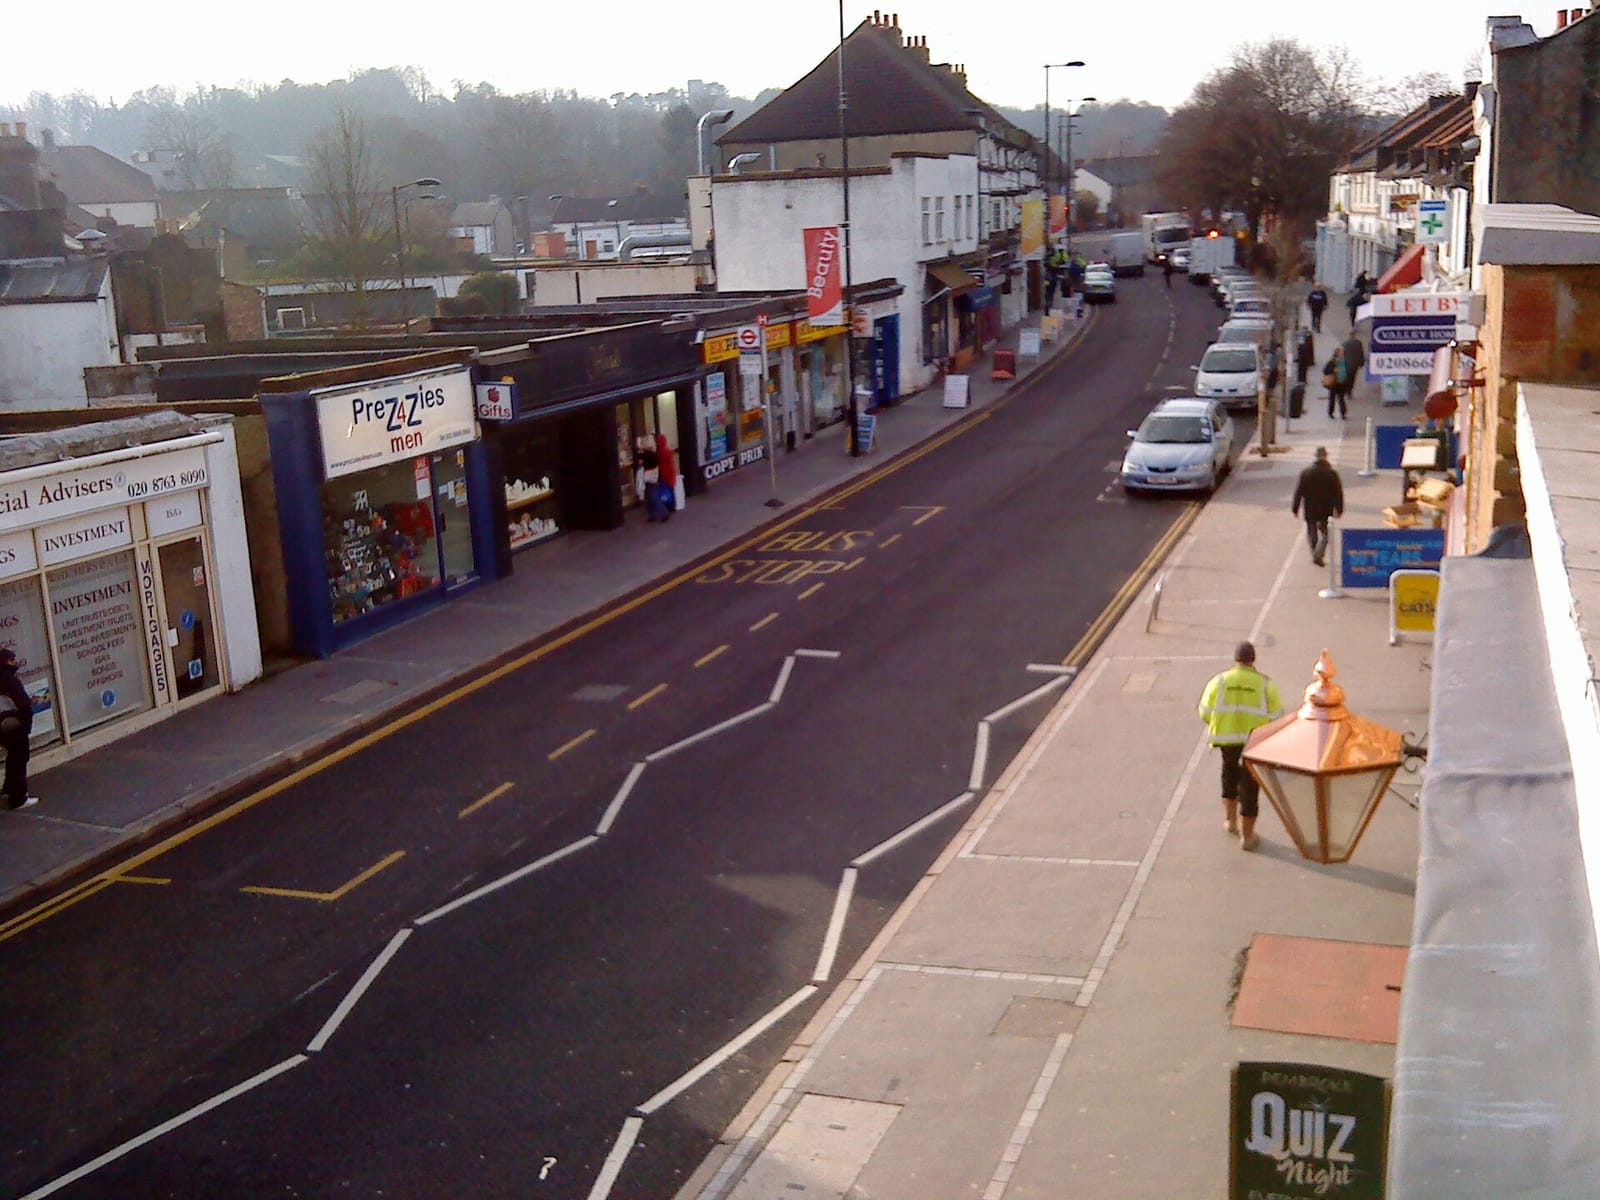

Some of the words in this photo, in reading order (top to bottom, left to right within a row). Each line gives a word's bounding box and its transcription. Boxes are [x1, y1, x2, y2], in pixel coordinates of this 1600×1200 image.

[807, 230, 838, 298] Beauty
[479, 403, 511, 418] Gifts
[391, 431, 423, 453] men
[704, 456, 736, 479] COPY
[38, 478, 114, 506] Advisers
[127, 482, 148, 497] 020
[152, 474, 176, 493] 8763
[180, 468, 205, 485] 8090
[44, 520, 125, 552] INVESTMENT
[758, 531, 874, 551] BUS
[695, 560, 845, 584] STOP
[53, 580, 132, 616] INVESTMENT
[1276, 1159, 1351, 1194] Night
